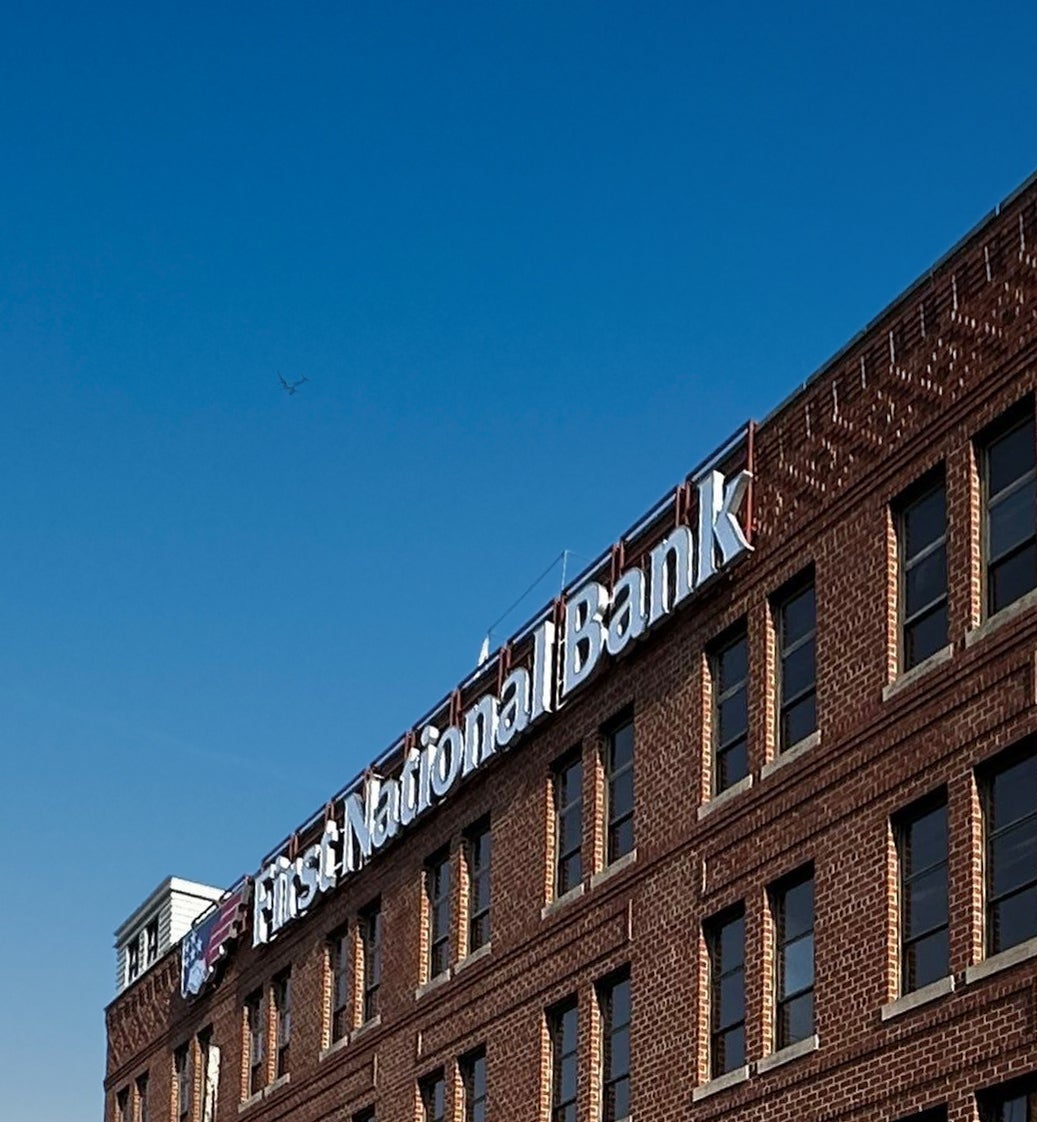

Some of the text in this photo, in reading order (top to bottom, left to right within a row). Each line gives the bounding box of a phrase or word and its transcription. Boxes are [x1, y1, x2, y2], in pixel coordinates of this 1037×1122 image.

[252, 470, 755, 948] First National Bank
